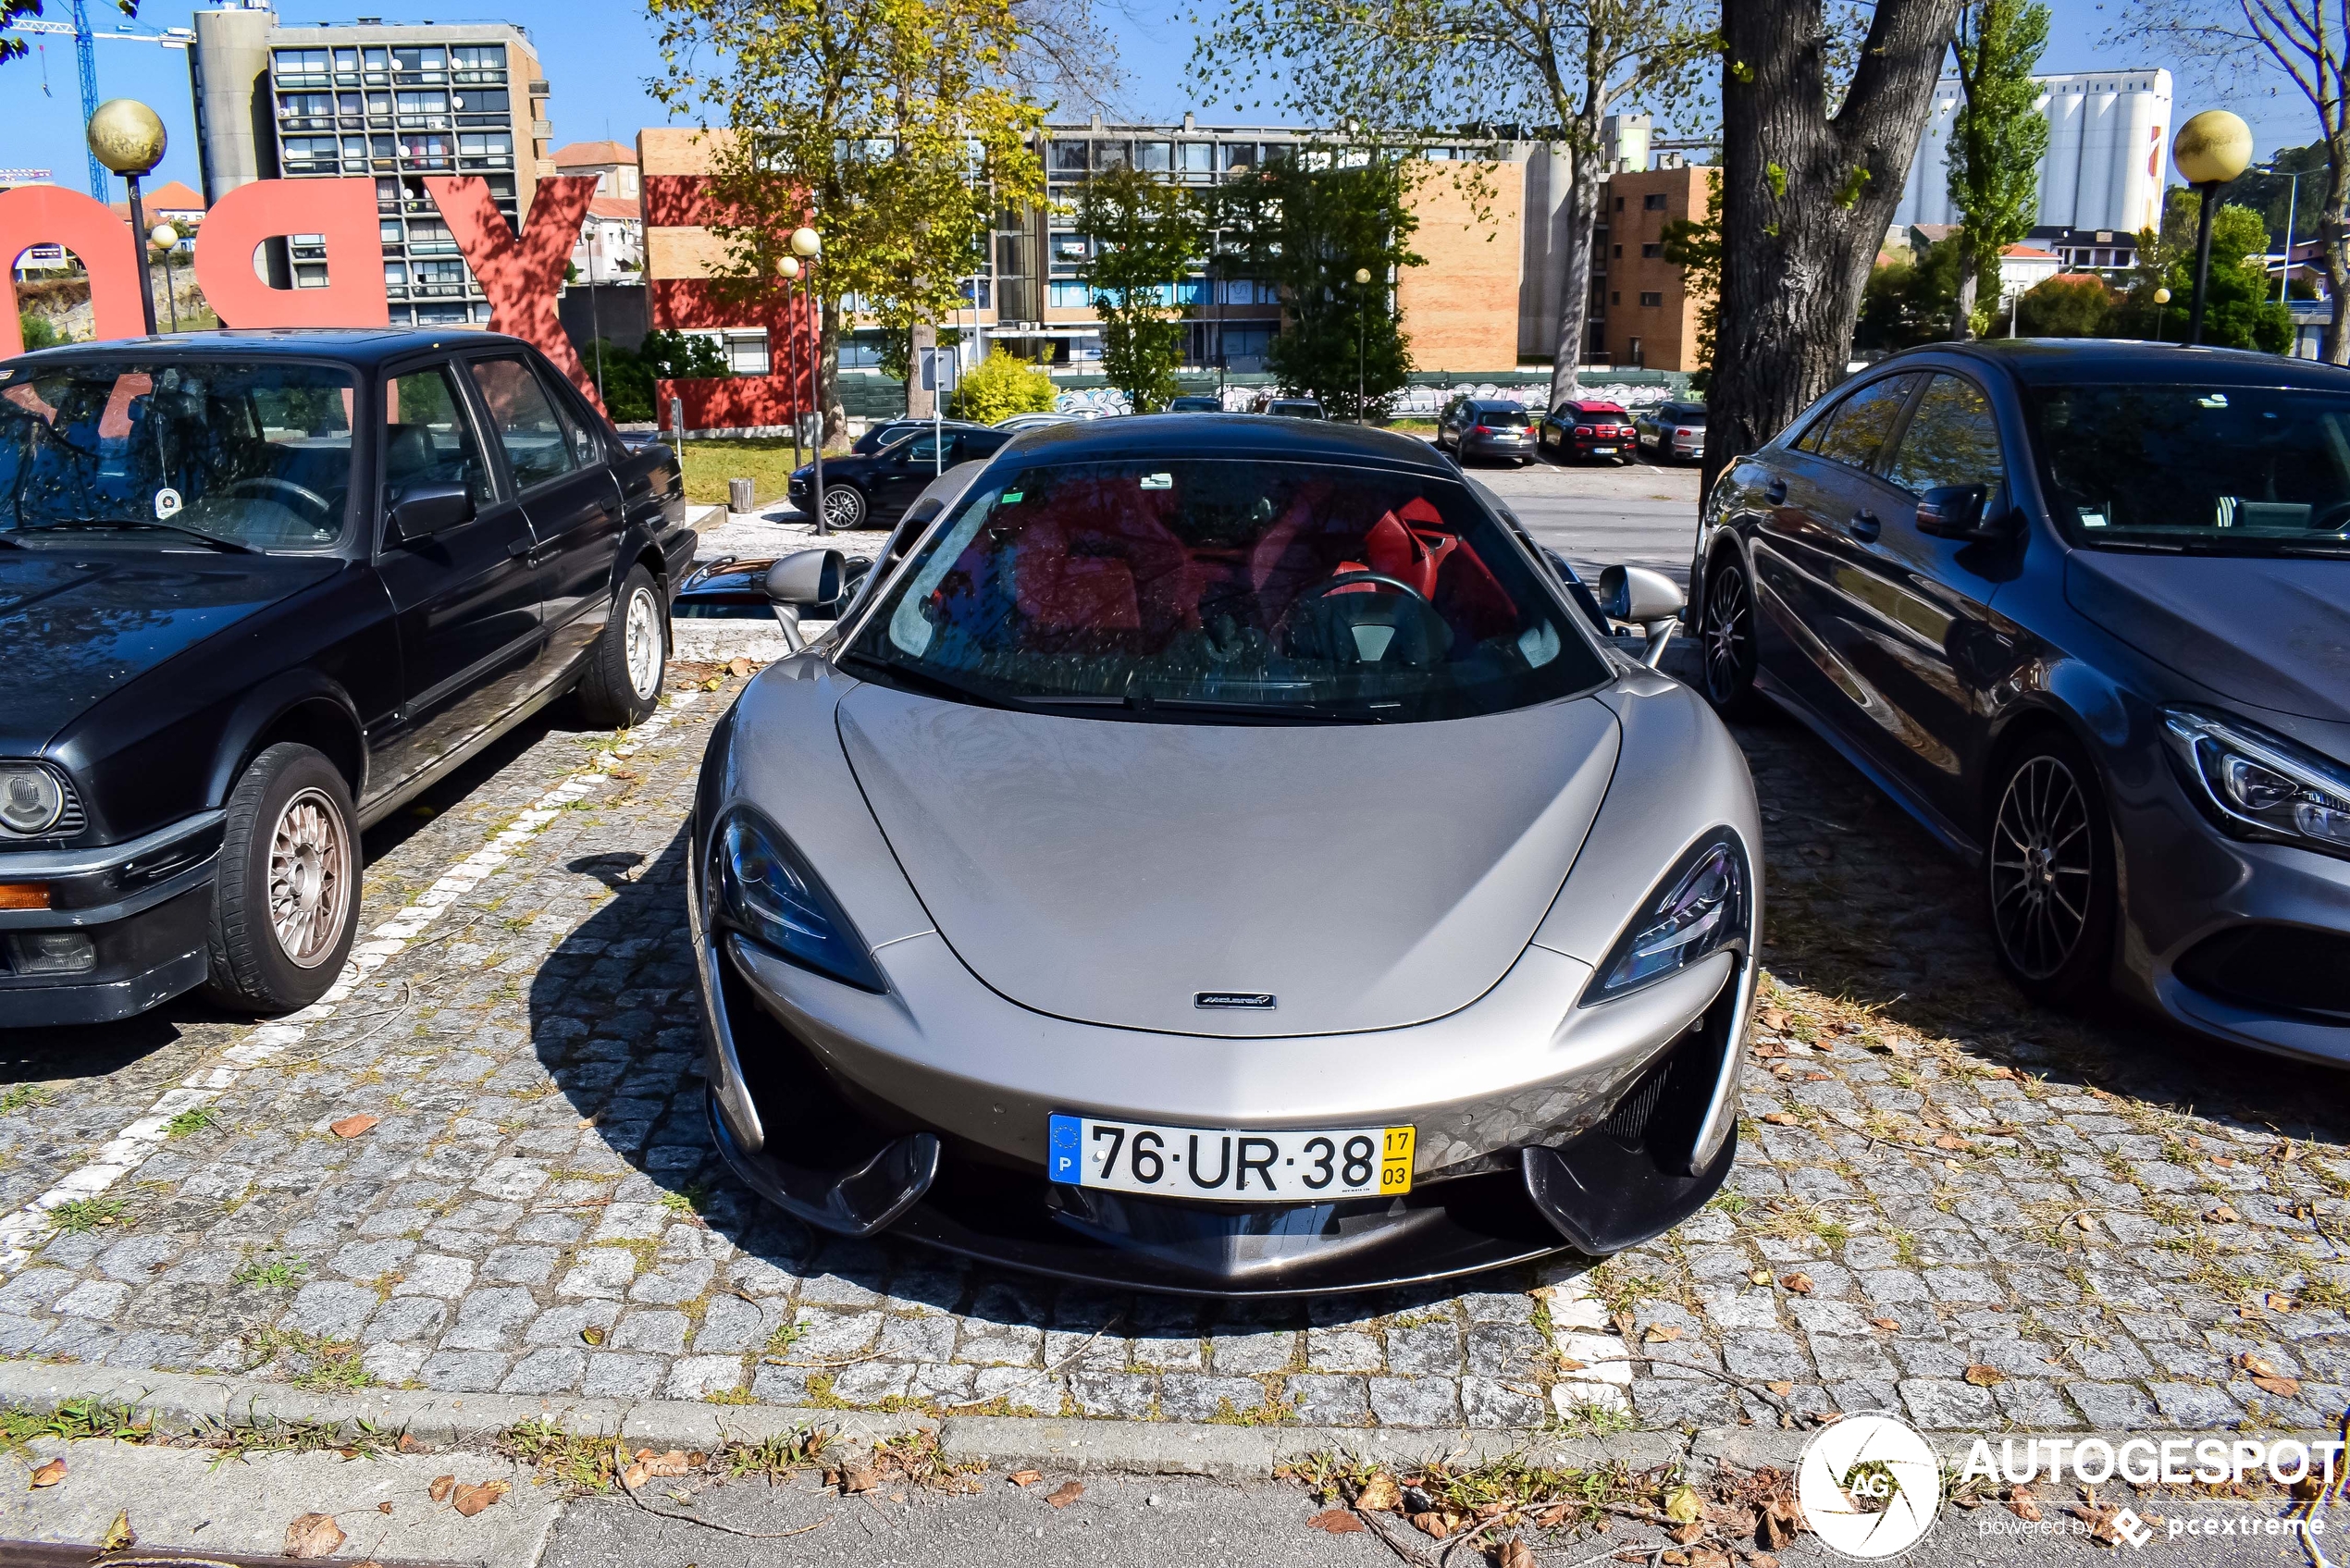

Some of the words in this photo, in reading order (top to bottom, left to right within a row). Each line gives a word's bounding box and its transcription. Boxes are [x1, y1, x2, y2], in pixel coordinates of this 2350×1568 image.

[1202, 995, 1268, 1005] McLaren
[1385, 1132, 1409, 1151] 17
[1058, 1156, 1071, 1172] P
[1381, 1168, 1406, 1185] 03
